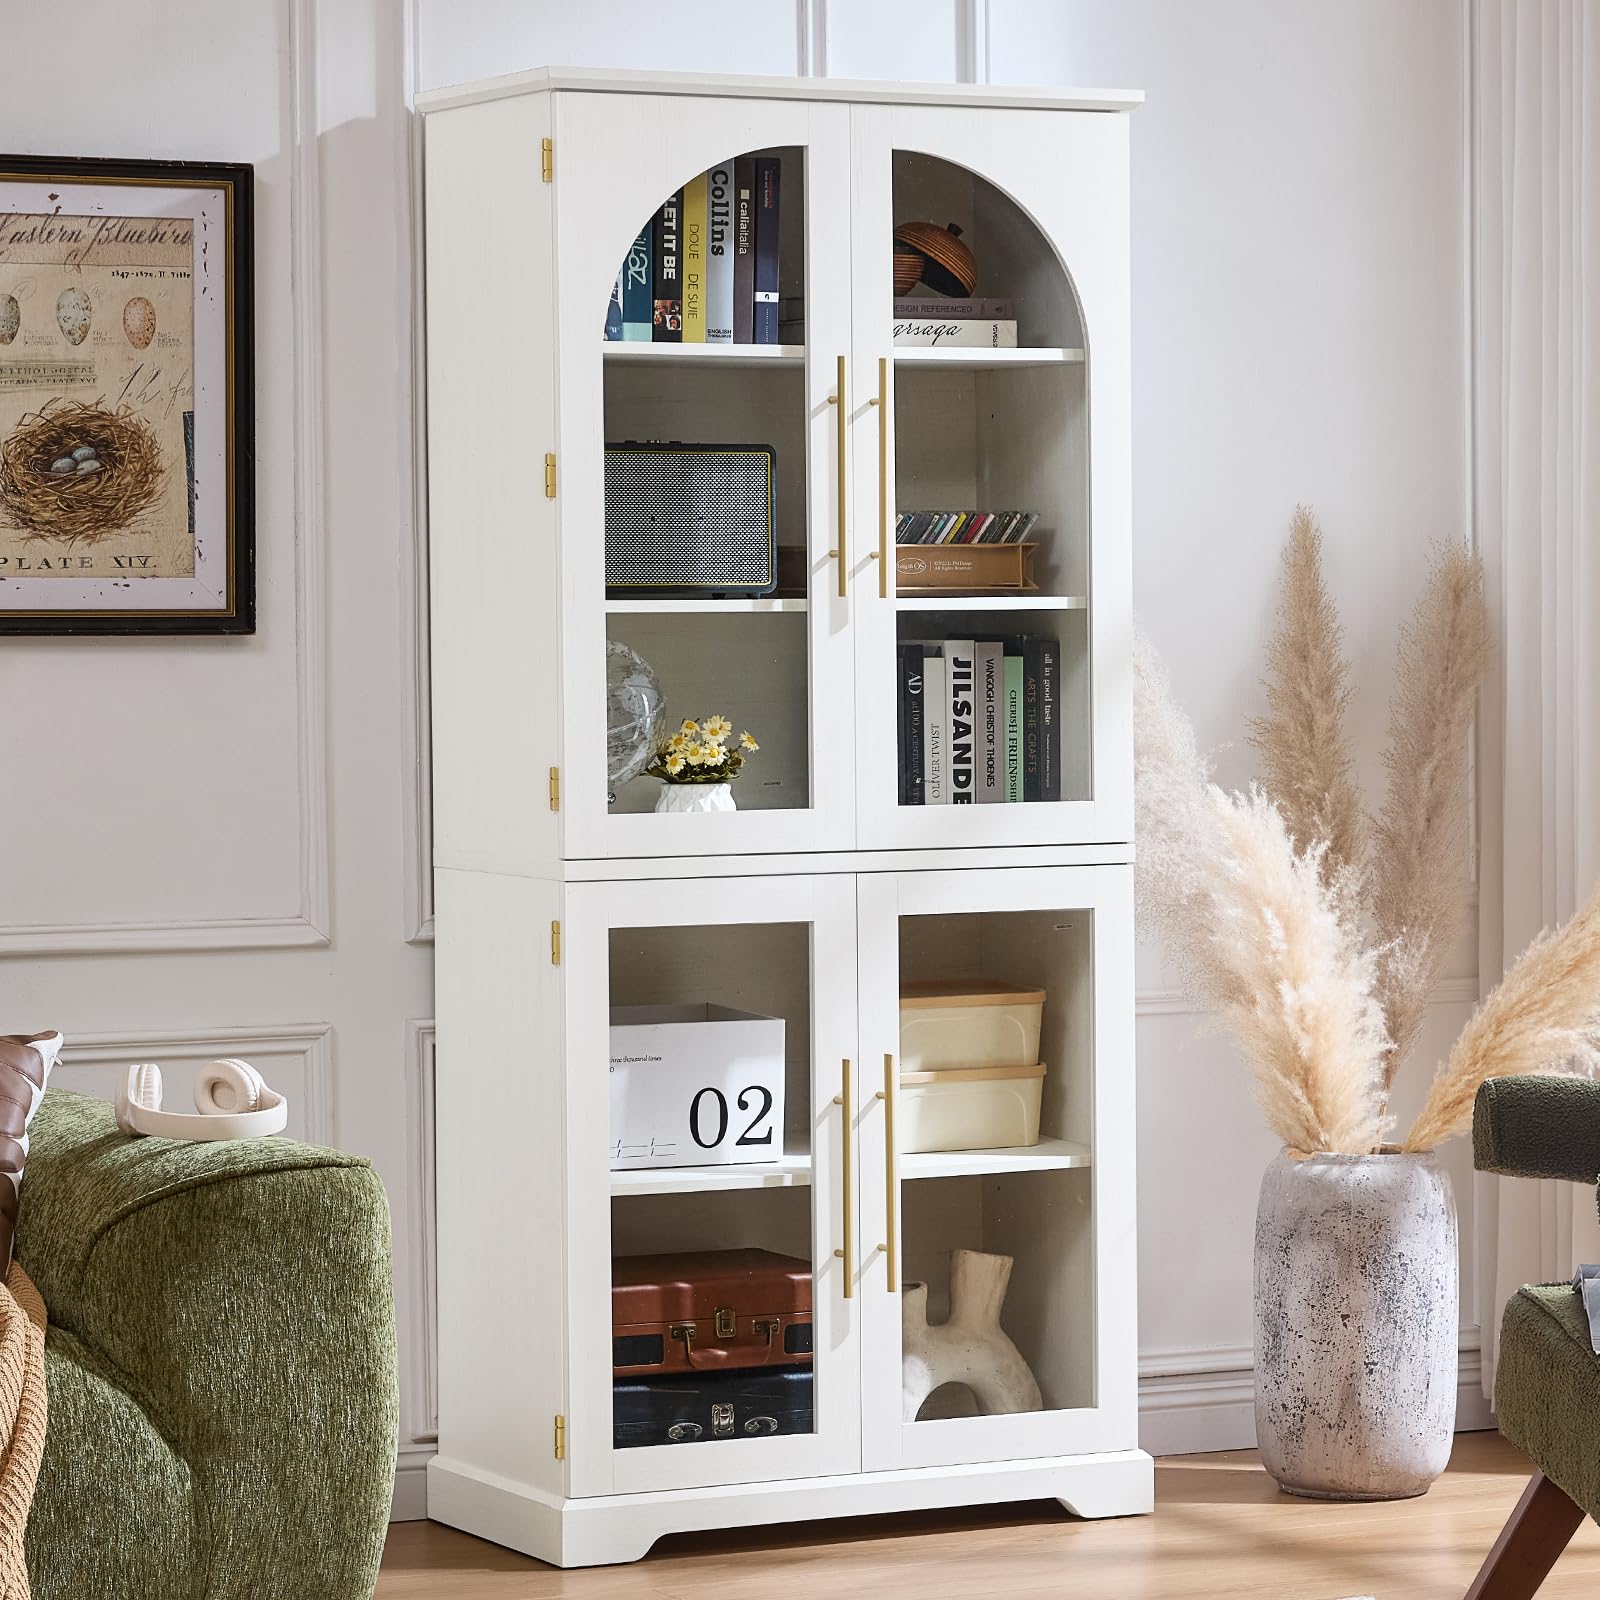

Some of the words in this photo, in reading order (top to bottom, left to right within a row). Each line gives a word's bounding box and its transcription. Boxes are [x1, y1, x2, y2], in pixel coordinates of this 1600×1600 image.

[710, 169, 730, 257] Collins
[739, 201, 750, 255] caliaitalia
[663, 234, 677, 251] IT
[663, 256, 677, 280] BE
[688, 273, 699, 290] DE
[687, 293, 698, 320] SUIE
[895, 303, 919, 313] ESIGN
[920, 304, 973, 314] REFERENCED
[1043, 653, 1053, 665] all
[1044, 666, 1053, 677] in
[908, 672, 922, 695] AD
[985, 658, 995, 703] VANGOGH
[1027, 676, 1037, 703] ARTS
[1042, 679, 1053, 702] good
[1008, 689, 1018, 733] CHERISH
[1027, 705, 1037, 729] THE
[1044, 704, 1053, 726] taste
[930, 723, 941, 755] TWIST
[952, 656, 972, 804] JILSANDE
[986, 705, 995, 746] CHRISTOF
[1027, 733, 1037, 774] CRAFTS
[931, 756, 941, 799] OLIVER
[986, 748, 995, 788] THOENES
[609, 1056, 622, 1064] hree
[689, 1085, 773, 1149] 02
